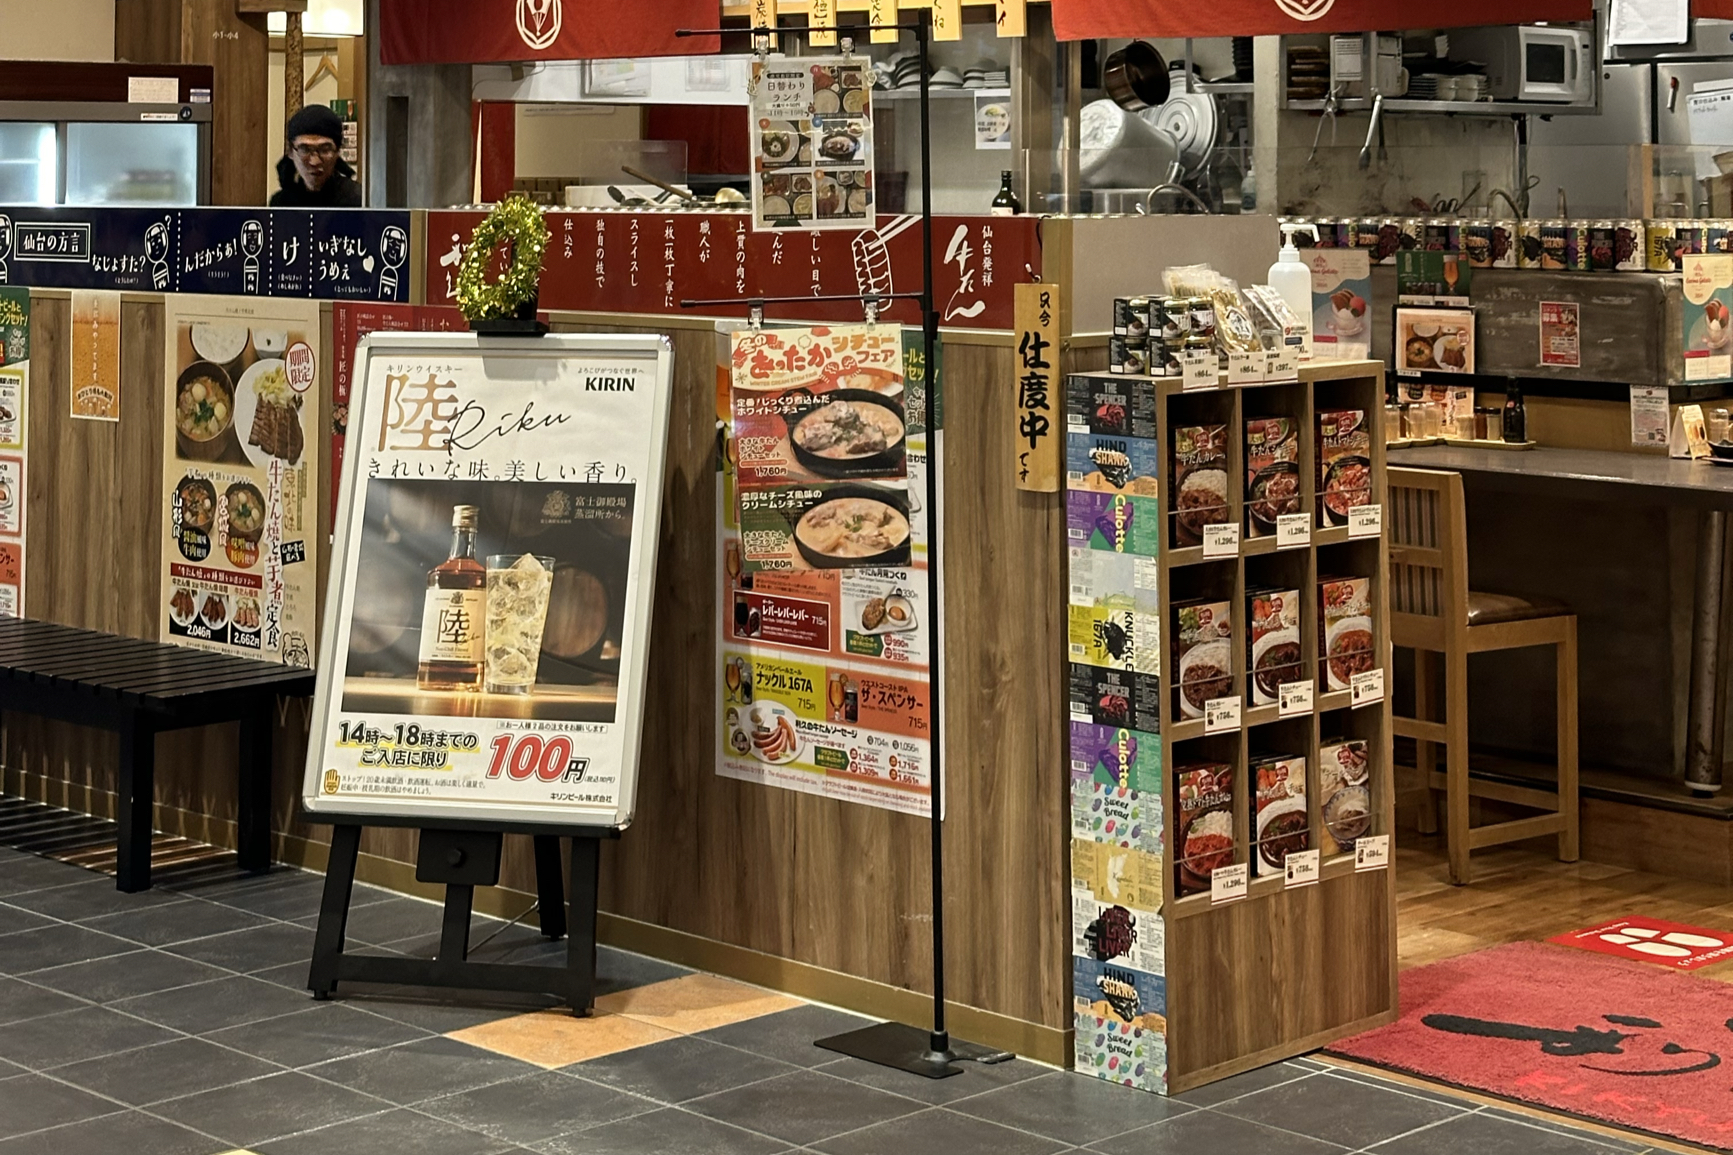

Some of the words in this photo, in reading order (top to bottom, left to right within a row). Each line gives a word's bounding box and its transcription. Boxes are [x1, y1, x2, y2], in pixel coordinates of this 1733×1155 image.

[773, 94, 801, 102] ランチ
[23, 231, 81, 253] 仙台の方言
[318, 234, 367, 257] いぎなし
[564, 218, 573, 259] 仕込み
[699, 220, 711, 263] 職人が
[772, 231, 783, 265] んだ
[1577, 228, 1587, 270] Culotte
[185, 237, 238, 273] んだからぁ!
[282, 236, 300, 267] け
[595, 219, 606, 288] 独自の技で
[630, 219, 639, 287] スライスし
[736, 220, 746, 294] 上質の肉を
[981, 225, 994, 287] 仙台発祥
[92, 254, 147, 273] なじょすた?
[664, 219, 676, 308] 一枚一枚丁寧に
[1039, 292, 1051, 327] 只今
[831, 333, 896, 354] シチュー
[289, 348, 310, 367] 期間
[750, 342, 832, 379] あったか
[856, 348, 896, 365] フェア
[290, 366, 312, 386] 限定
[386, 364, 463, 374] キリンウイスキー
[585, 377, 635, 392] KIRIN
[1019, 331, 1051, 450] 仕度中
[1103, 382, 1118, 394] THE
[737, 406, 807, 416] ホワイトシチュー
[1095, 394, 1127, 406] SPENCER
[378, 373, 459, 452] 陸
[442, 399, 572, 456] Riku
[1096, 438, 1127, 452] HIND
[367, 457, 638, 484] きれいな味。美しい香り。
[742, 500, 814, 511] クリームシチュー
[1114, 493, 1127, 553] Culotte
[762, 605, 809, 621] レバーレバーレバー
[187, 624, 211, 639] 2,046円
[437, 609, 470, 644] 陸
[1093, 619, 1102, 648] 167A
[234, 632, 260, 648] 2,662円
[1124, 611, 1135, 672] KNUCKLE
[756, 671, 786, 689] ナックル
[789, 675, 813, 694] 167A
[1106, 671, 1121, 685] THE
[861, 687, 924, 710] ザ・スペンサー
[1098, 683, 1130, 698] SPENCER
[361, 748, 448, 767] ご入店に限り
[487, 733, 590, 783] 100円
[1118, 728, 1130, 789] Culotte
[550, 792, 613, 803] キリンビール株式会社
[1104, 796, 1129, 810] Sweet
[1103, 804, 1130, 821] Bread
[1103, 967, 1135, 986] HIND
[1107, 1032, 1132, 1047] Sweet
[1107, 1044, 1132, 1059] Bread
